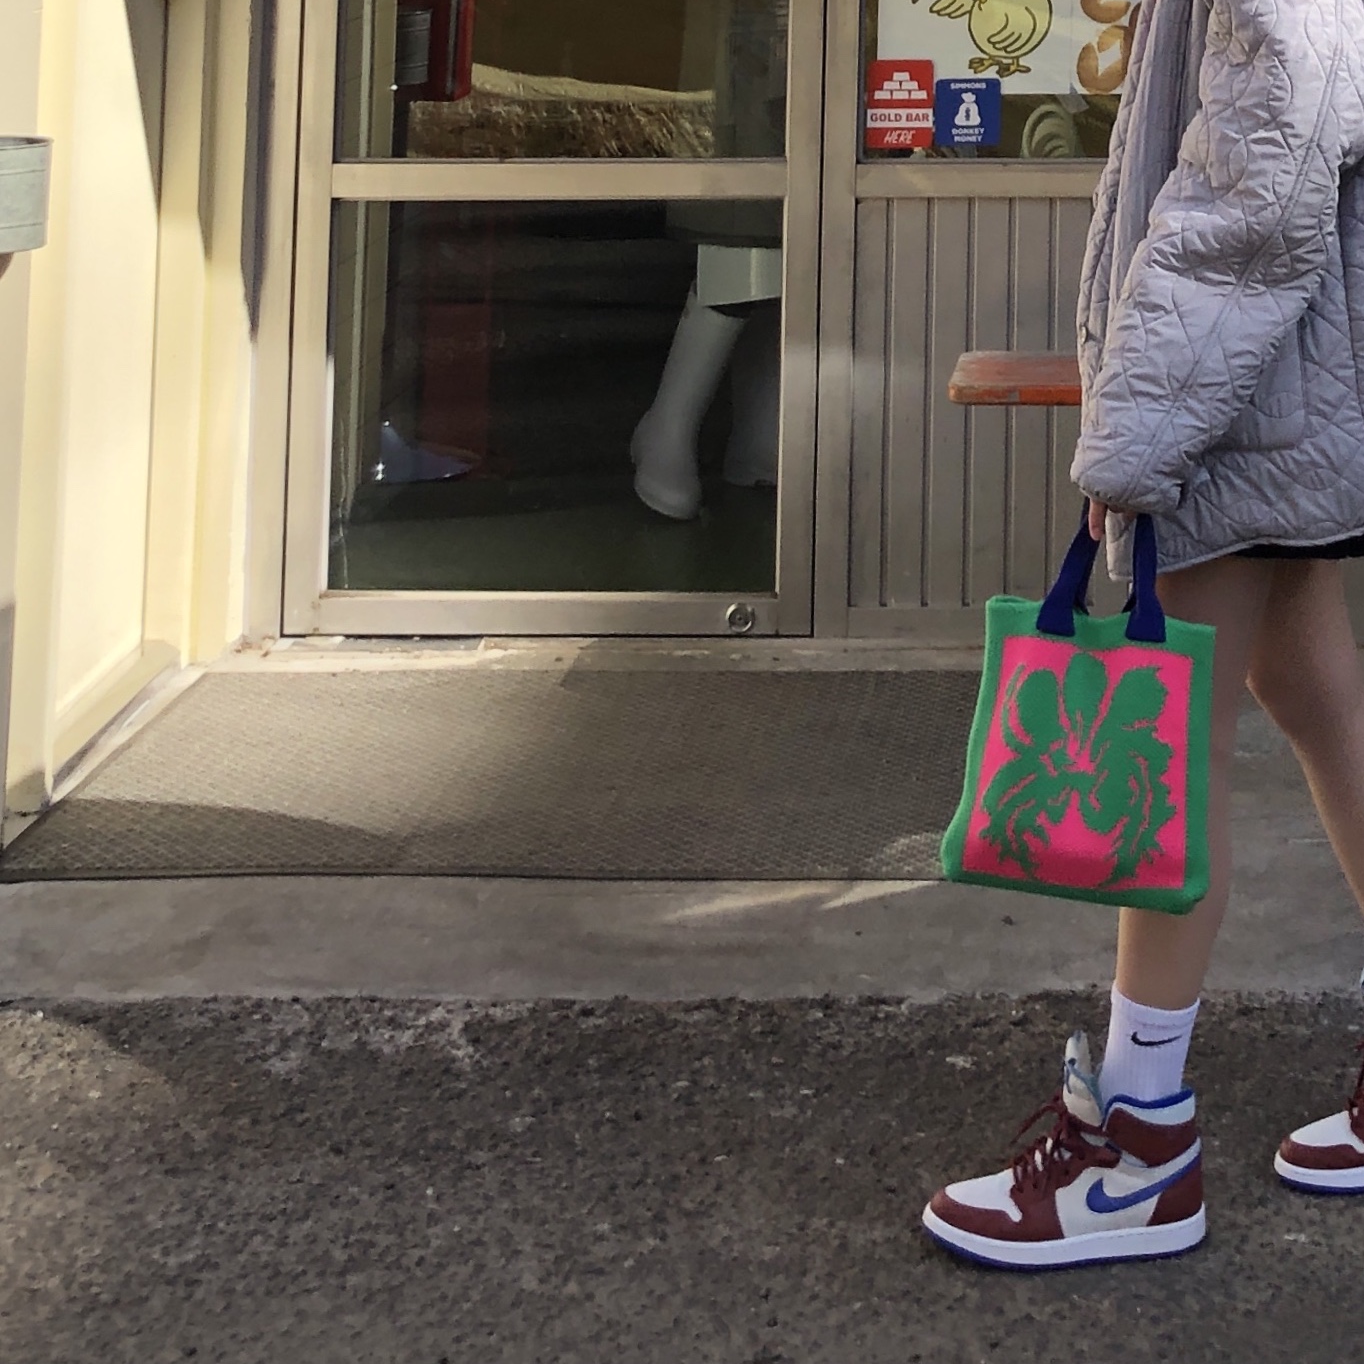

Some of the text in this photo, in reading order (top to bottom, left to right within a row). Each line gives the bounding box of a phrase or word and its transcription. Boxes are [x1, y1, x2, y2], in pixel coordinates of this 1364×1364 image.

[870, 112, 930, 123] GOLD BAR
[883, 129, 916, 145] HERE
